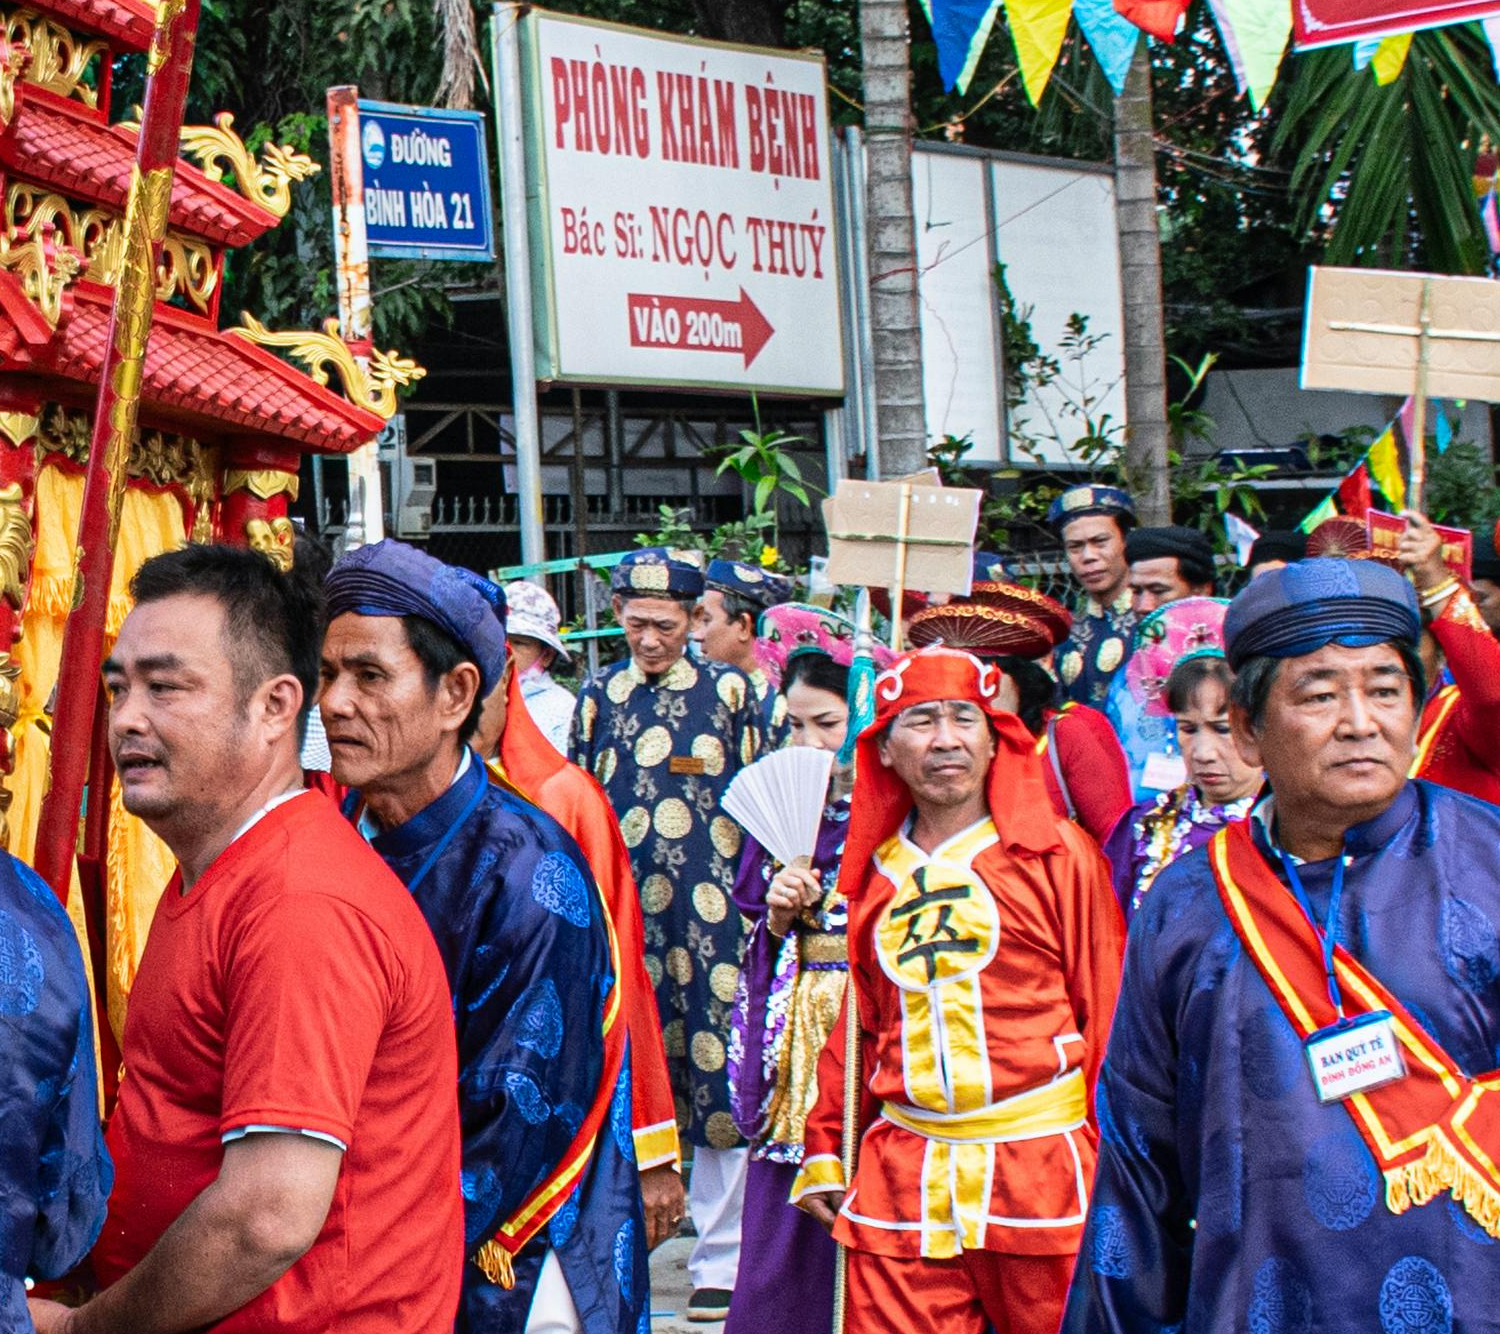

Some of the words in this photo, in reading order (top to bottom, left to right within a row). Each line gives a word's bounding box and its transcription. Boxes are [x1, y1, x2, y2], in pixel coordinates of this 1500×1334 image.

[551, 44, 650, 159] PHÒNG
[656, 61, 740, 169] KHÁM
[745, 71, 820, 190] BỆNH
[391, 128, 452, 167] ĐƯỜNG
[365, 179, 406, 227] BÌNH
[410, 181, 448, 229] HÒA
[450, 192, 475, 229] 21
[560, 206, 606, 256] Bác
[649, 205, 736, 281] NGỌC
[633, 298, 680, 345] VÀO
[686, 310, 742, 348] 200m
[890, 866, 979, 984] 卒
[1320, 1051, 1343, 1068] BAN
[1378, 1054, 1392, 1065] AN
